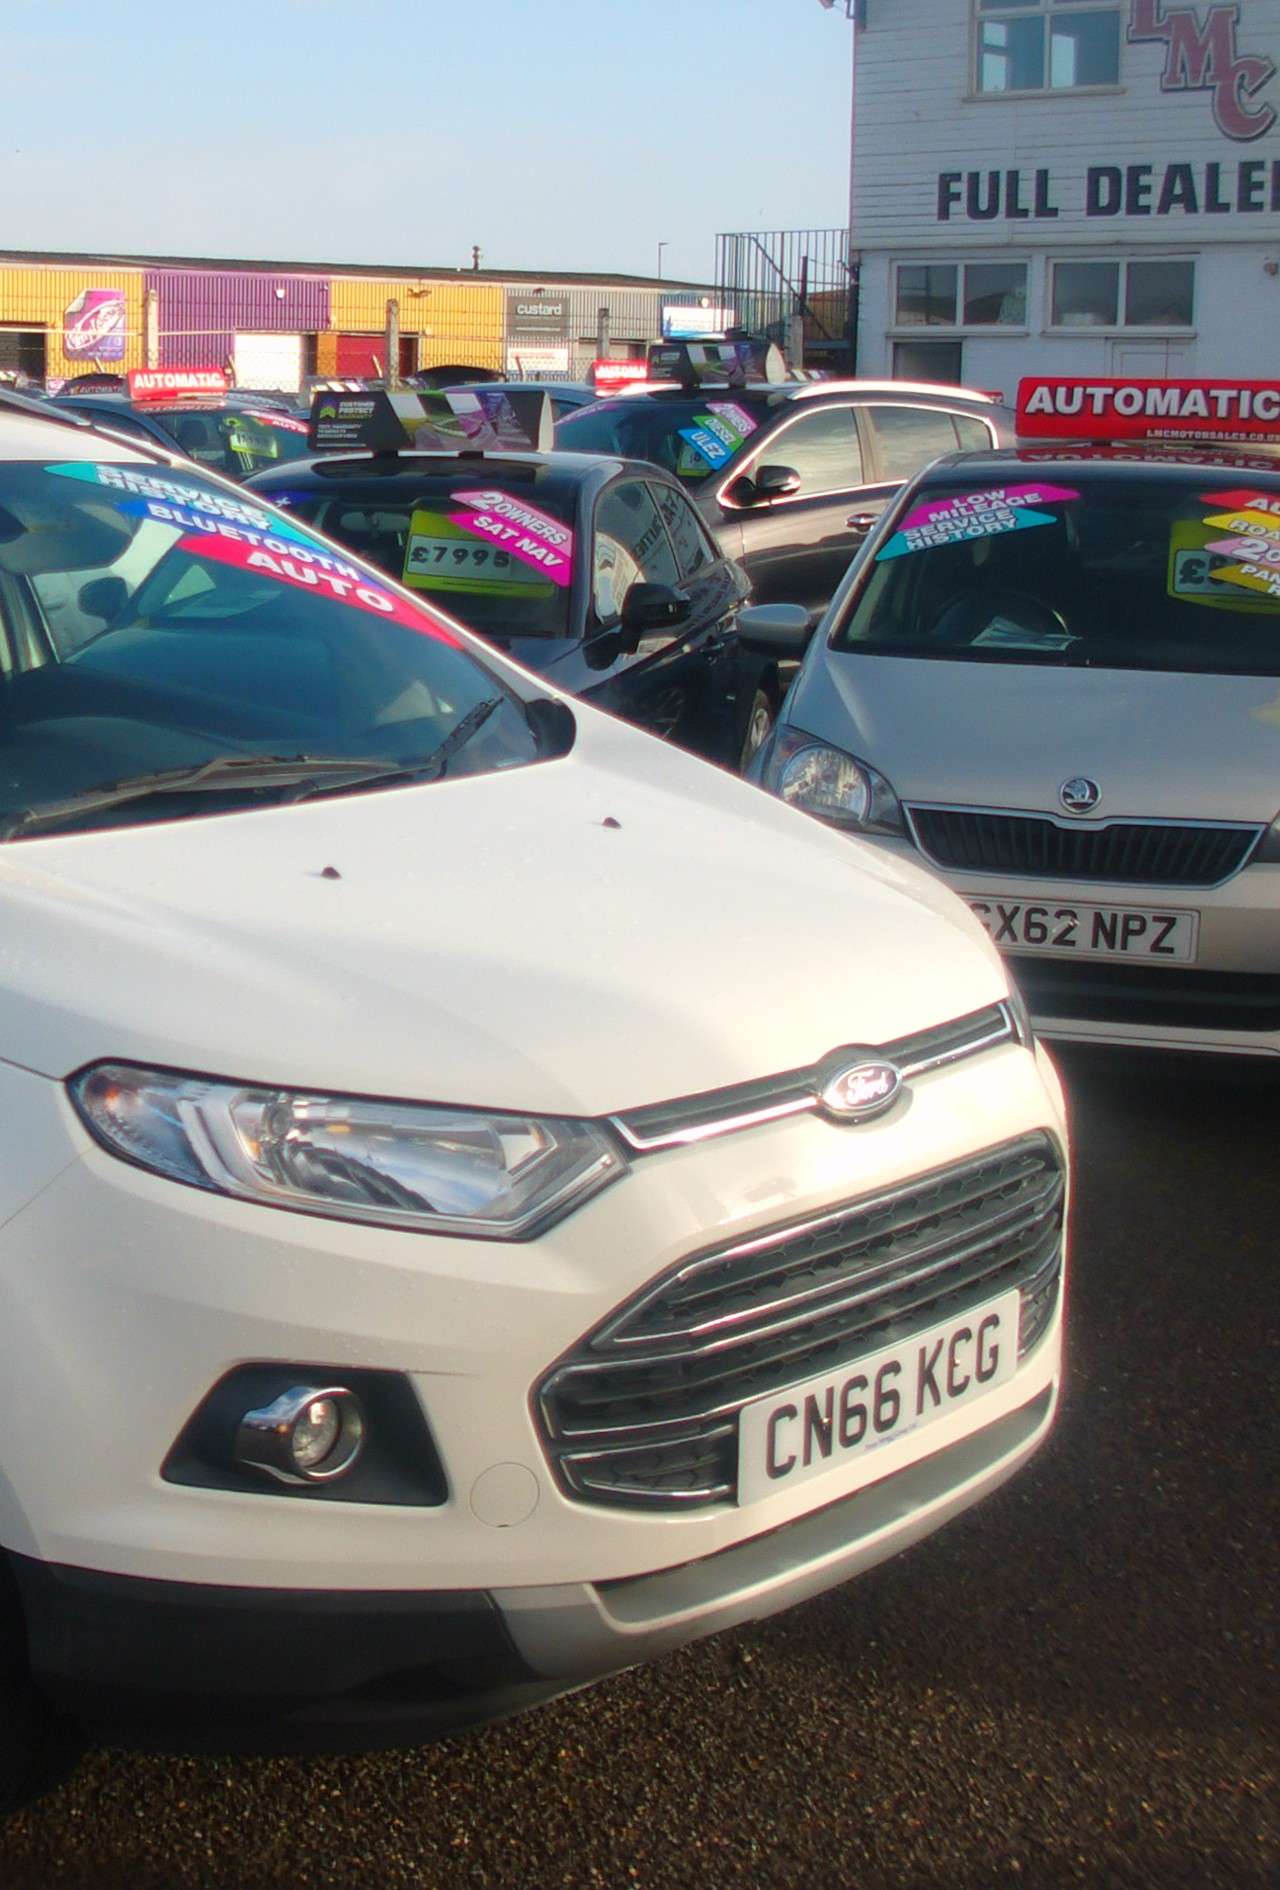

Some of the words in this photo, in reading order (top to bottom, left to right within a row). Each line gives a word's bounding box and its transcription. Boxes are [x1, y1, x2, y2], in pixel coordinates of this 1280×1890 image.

[937, 169, 1059, 221] FULL
[1086, 160, 1280, 217] DEALE
[517, 303, 562, 316] custard
[134, 373, 224, 388] AUTOMATIC
[1024, 386, 1280, 420] AUTOMATIC
[690, 431, 726, 459] ULEZ
[95, 465, 269, 522] SERVICE
[97, 471, 271, 531] HISTORY
[928, 493, 1043, 523] MILEAGE
[952, 490, 1006, 508] LOW
[470, 491, 503, 511] 2
[494, 502, 567, 545] OWNERS
[904, 509, 1014, 540] SERVICE
[906, 518, 1018, 551] HISTORY
[147, 502, 361, 582] BLUETOOTH
[410, 546, 511, 568] £7995
[472, 516, 520, 541] SAT
[515, 537, 565, 567] NAV
[246, 551, 394, 613] AUTO
[1091, 911, 1178, 954] NPZ
[766, 1359, 902, 1480] CN66
[916, 1313, 1000, 1416] KCG
